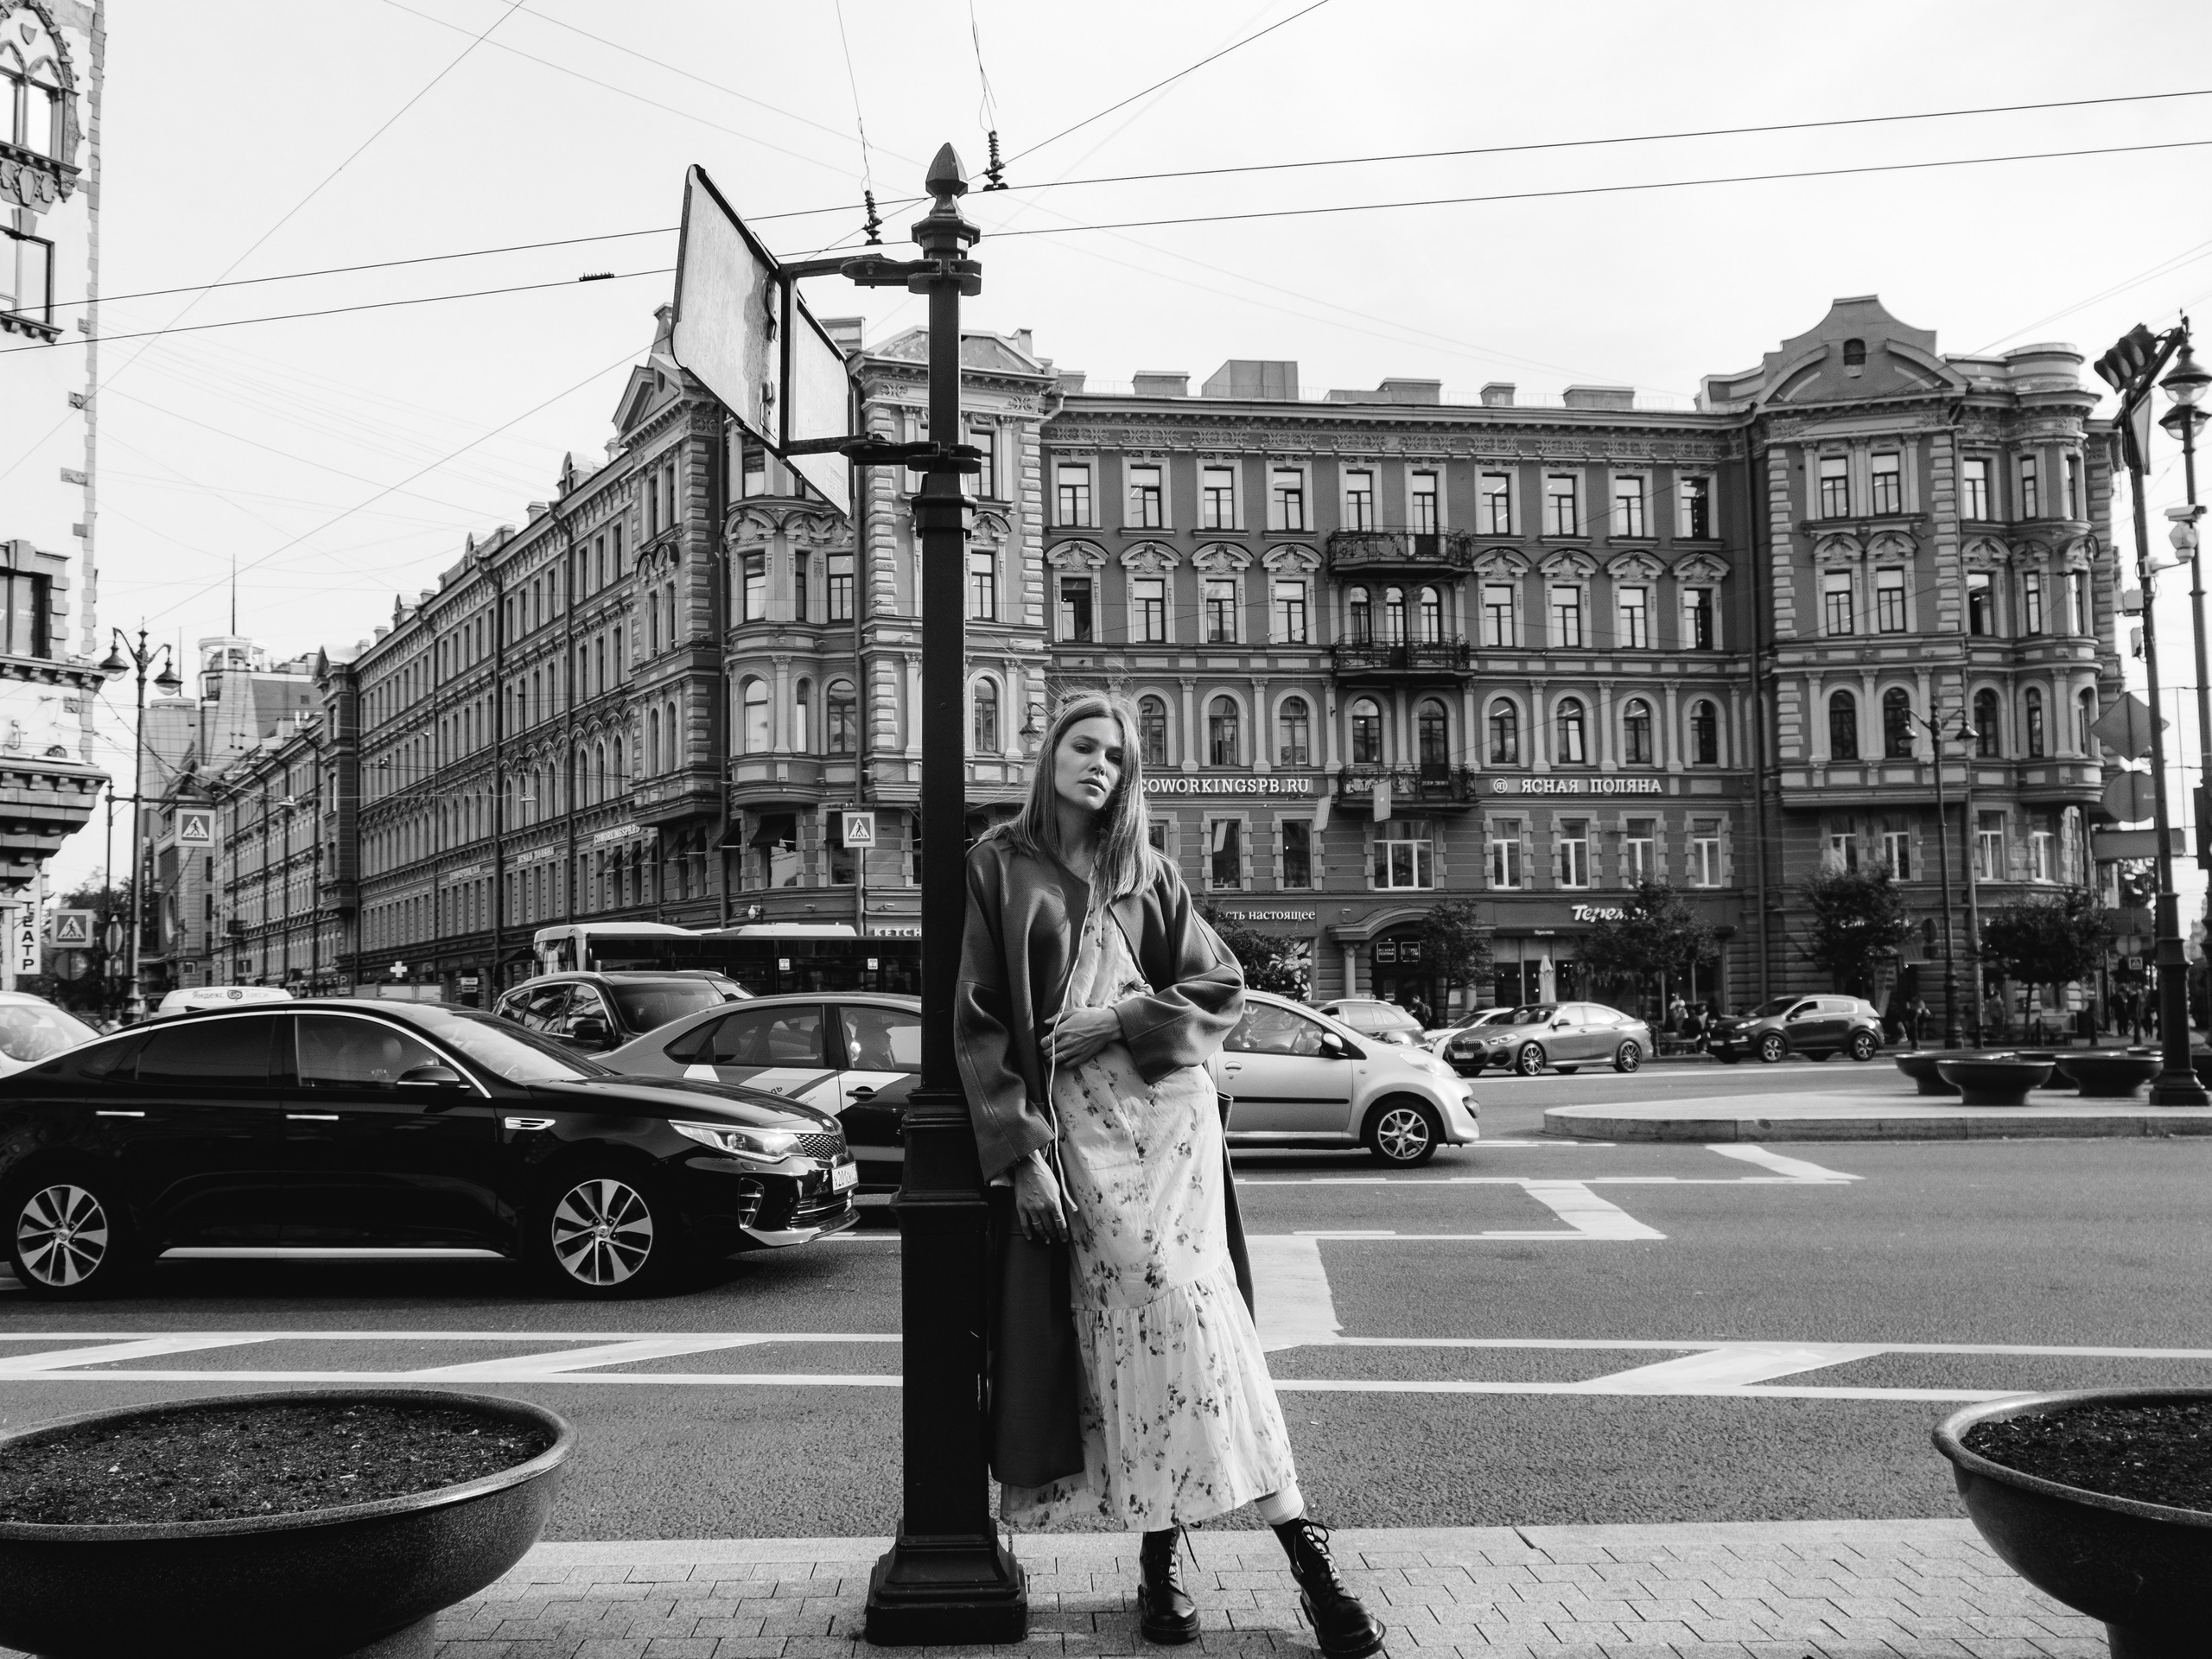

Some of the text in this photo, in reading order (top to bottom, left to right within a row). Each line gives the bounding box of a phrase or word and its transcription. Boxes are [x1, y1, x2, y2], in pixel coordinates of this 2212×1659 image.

[1521, 779, 1580, 793] ЯСНАЯ
[1590, 779, 1662, 793] ПОЛЯНА
[1249, 911, 1316, 922] настоящее
[22, 901, 35, 970] ТЕАТР
[192, 991, 225, 1000] Яндекс
